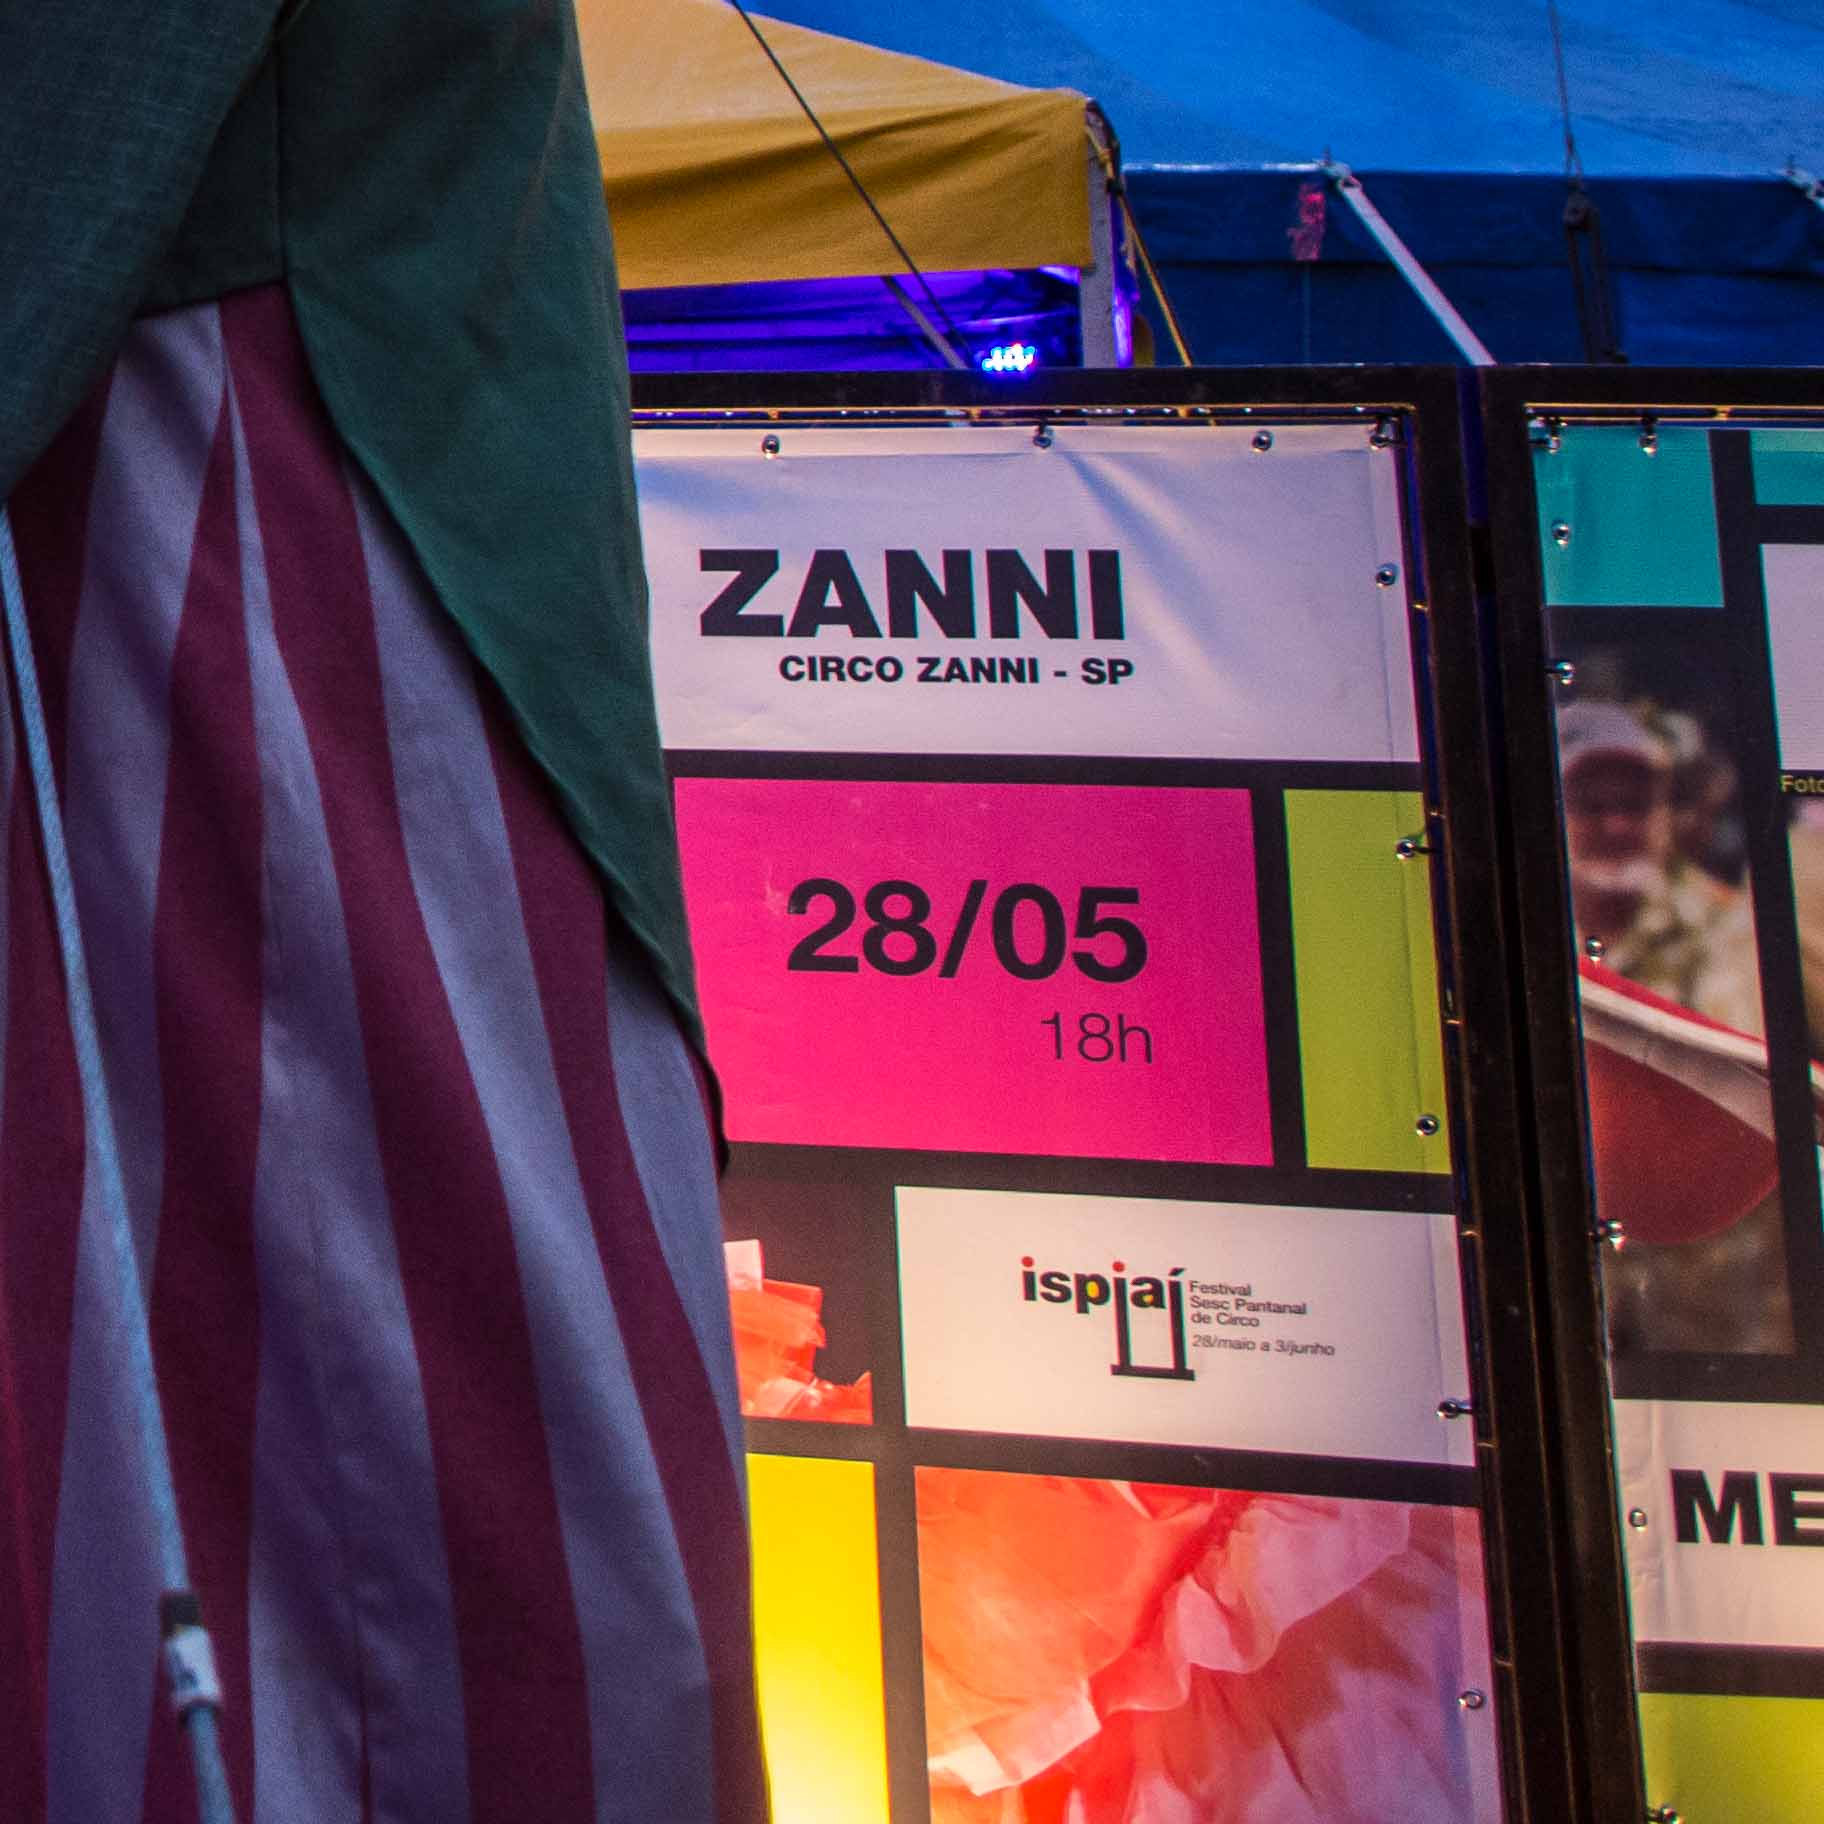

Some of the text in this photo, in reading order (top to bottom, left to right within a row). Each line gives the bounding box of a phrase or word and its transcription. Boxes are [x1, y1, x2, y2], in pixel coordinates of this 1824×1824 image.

[699, 548, 1126, 640] ZANNI
[778, 654, 904, 683] CIRCO
[917, 655, 1040, 685] ZANNI
[1080, 657, 1135, 686] SP
[786, 877, 1149, 984] 28/05
[1040, 1012, 1154, 1065] 18h
[1189, 1280, 1252, 1297] Festival
[1190, 1295, 1309, 1315] Sesc Pantanal
[1191, 1312, 1261, 1327] de Circo
[1259, 1340, 1271, 1352] a
[1669, 1468, 1824, 1547] ME
